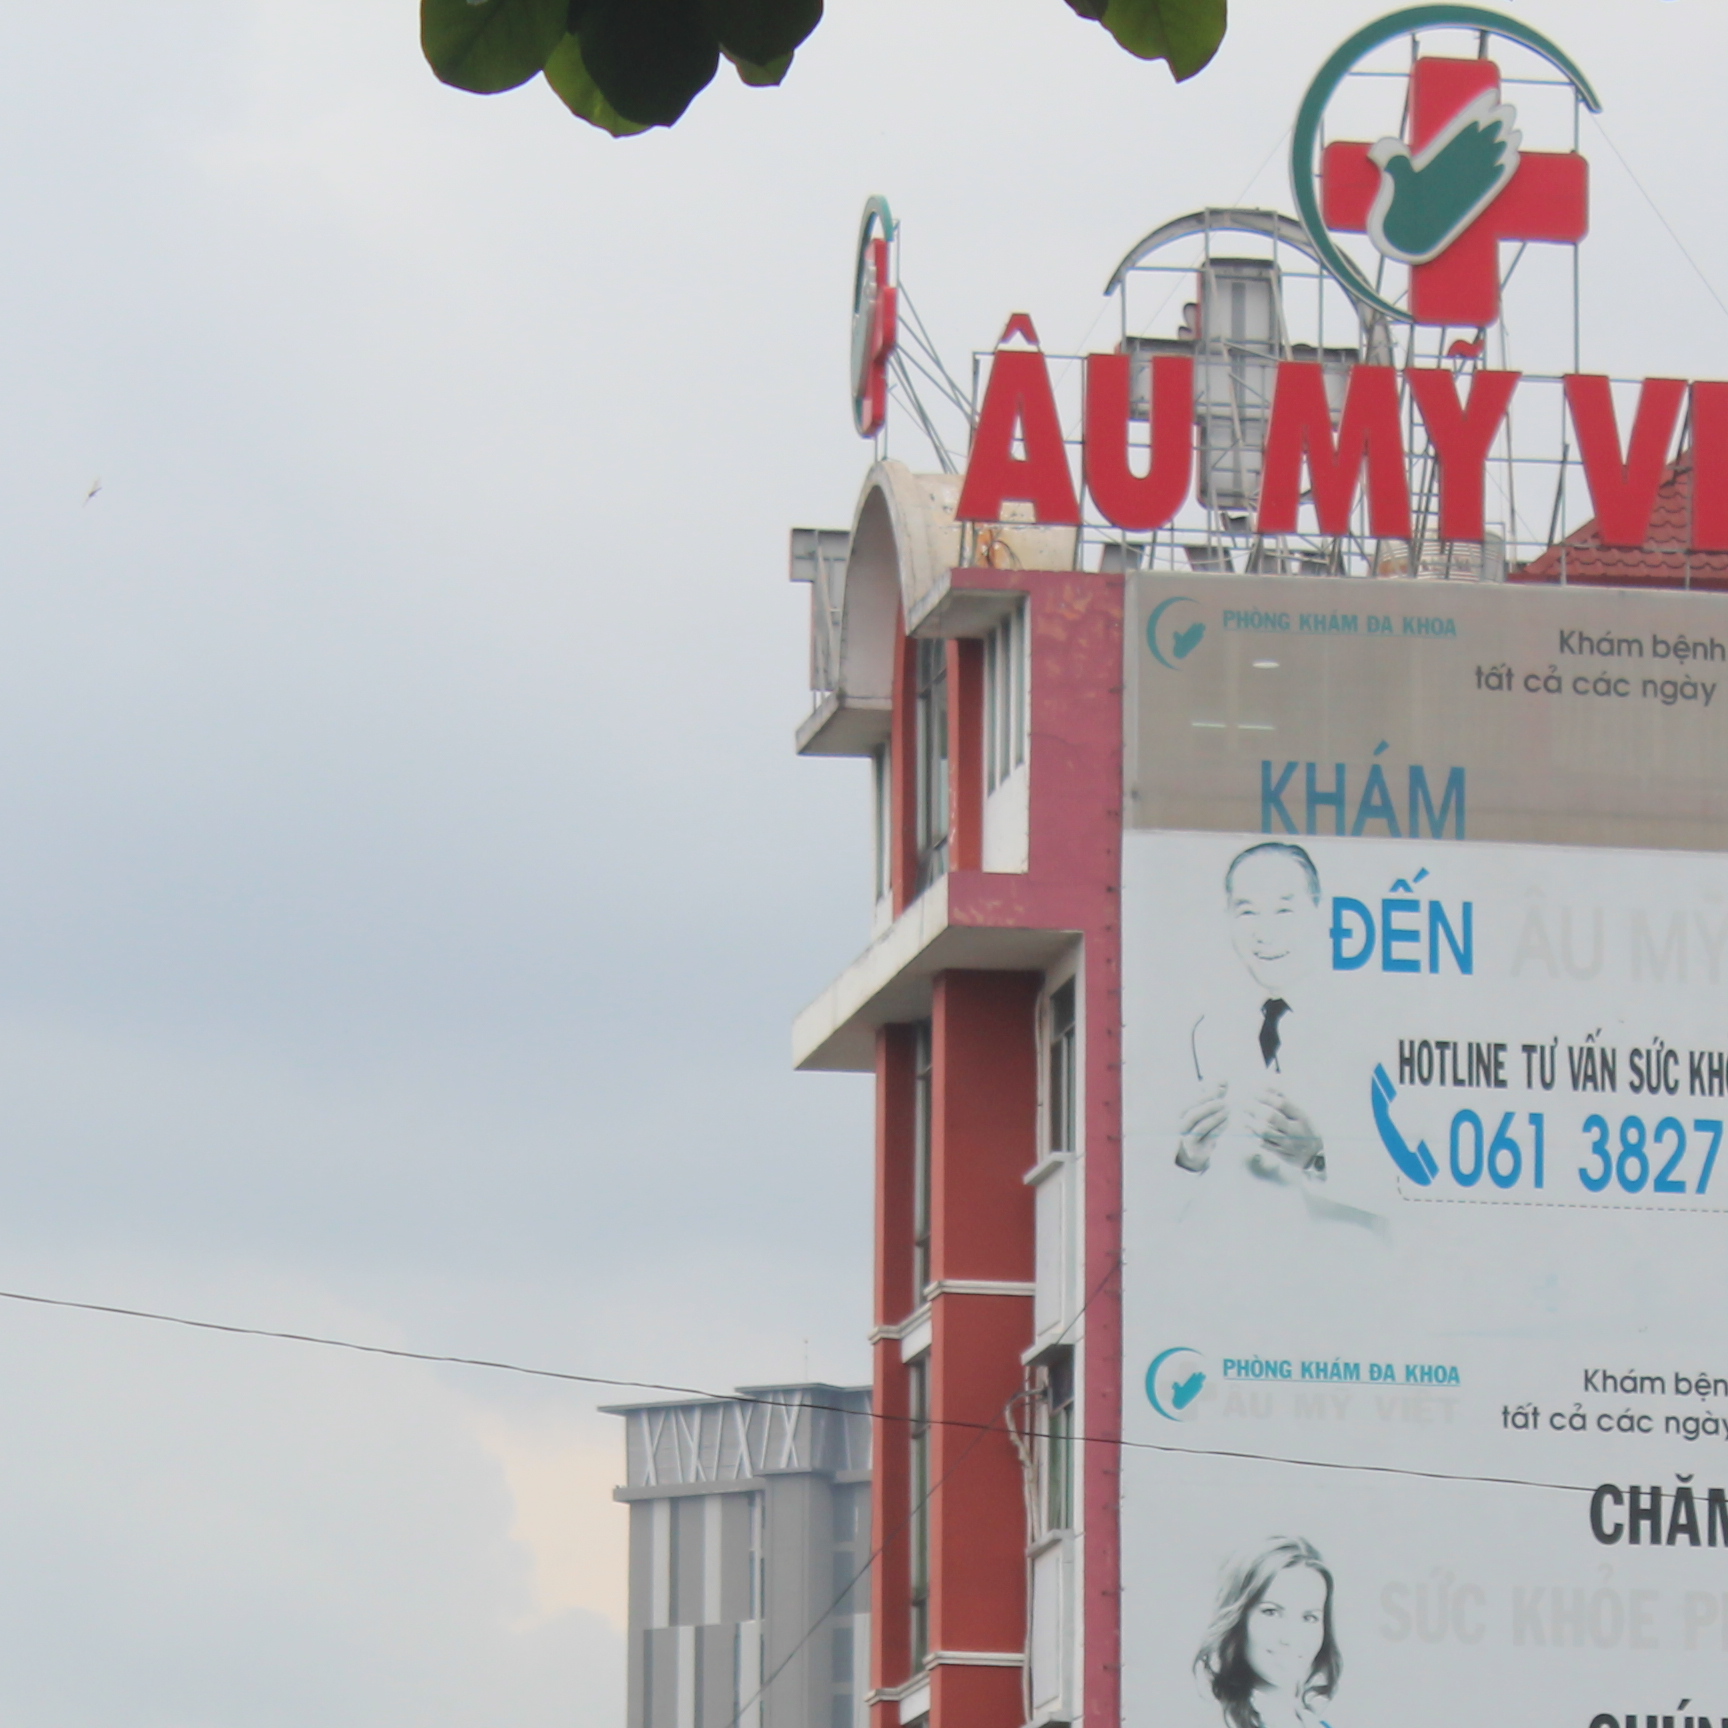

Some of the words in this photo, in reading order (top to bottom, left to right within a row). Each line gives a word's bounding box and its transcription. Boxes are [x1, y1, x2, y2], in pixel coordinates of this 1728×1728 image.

[956, 312, 1196, 532] ÂU
[1258, 337, 1523, 539] MỸ
[1223, 608, 1290, 632] PHÒNG
[1299, 609, 1359, 635] KHÁM
[1366, 614, 1394, 635] ĐA
[1402, 615, 1457, 638] KHOA
[1559, 629, 1644, 661] Khám
[1652, 632, 1726, 667] bệnh
[1475, 663, 1514, 693] tất
[1524, 664, 1562, 695] cả
[1571, 667, 1631, 698] các
[1643, 670, 1717, 709] ngày
[1259, 741, 1466, 842] KHÁM
[1329, 868, 1473, 975] ĐẾN
[1398, 1039, 1509, 1090] HOTLINE
[1522, 1036, 1560, 1091] TƯ
[1569, 1027, 1618, 1093] VẤN
[1628, 1036, 1680, 1096] SỨC
[1449, 1108, 1546, 1189] 061
[1578, 1114, 1724, 1195] 3827
[1223, 1355, 1293, 1381] PHÒNG
[1300, 1357, 1361, 1382] KHÁM
[1368, 1362, 1397, 1384] ĐA
[1405, 1363, 1460, 1387] KHOA
[1584, 1368, 1666, 1397] Khám
[1502, 1402, 1541, 1431] tất
[1549, 1402, 1588, 1433] cả
[1596, 1407, 1655, 1435] các
